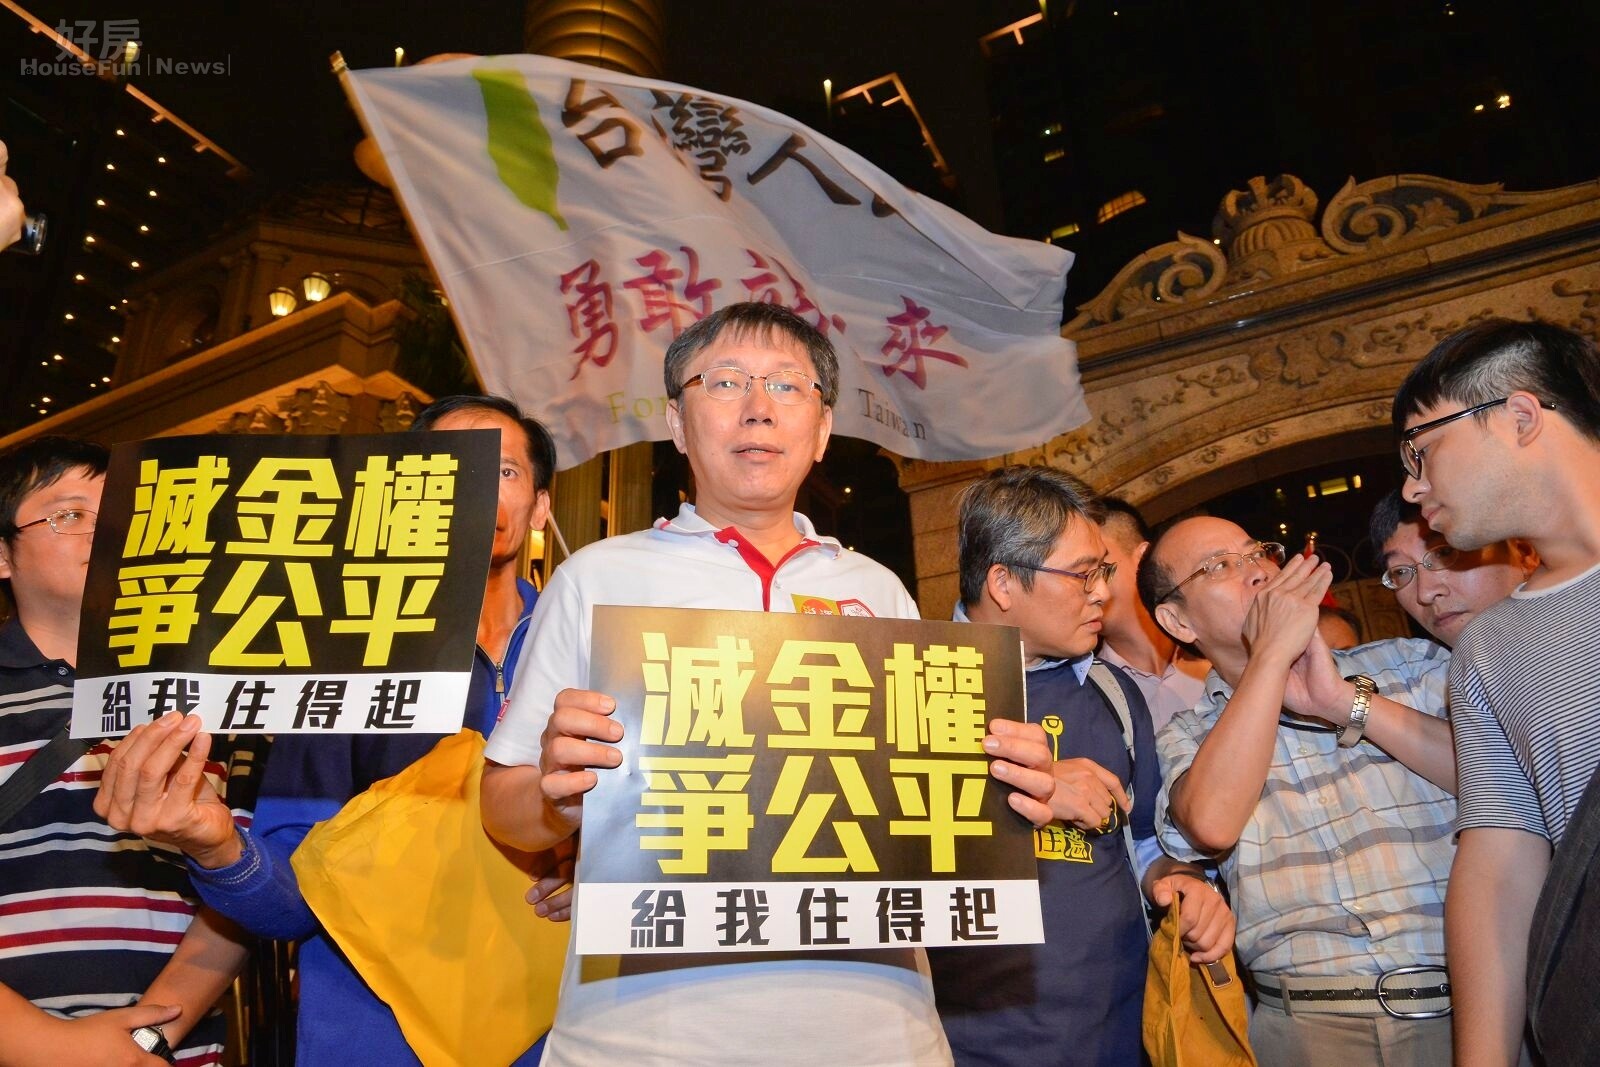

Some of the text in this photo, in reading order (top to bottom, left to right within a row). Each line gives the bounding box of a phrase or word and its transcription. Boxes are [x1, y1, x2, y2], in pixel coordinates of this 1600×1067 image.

[561, 79, 896, 217] 台灣人
[857, 388, 926, 440] Taiwan
[122, 453, 459, 559] 滅金權
[108, 559, 445, 668] 爭公平
[101, 677, 421, 733] 給我住得起
[640, 632, 985, 754] 滅金權
[635, 754, 993, 875] 爭公平
[630, 886, 1000, 948] 給我住得起
